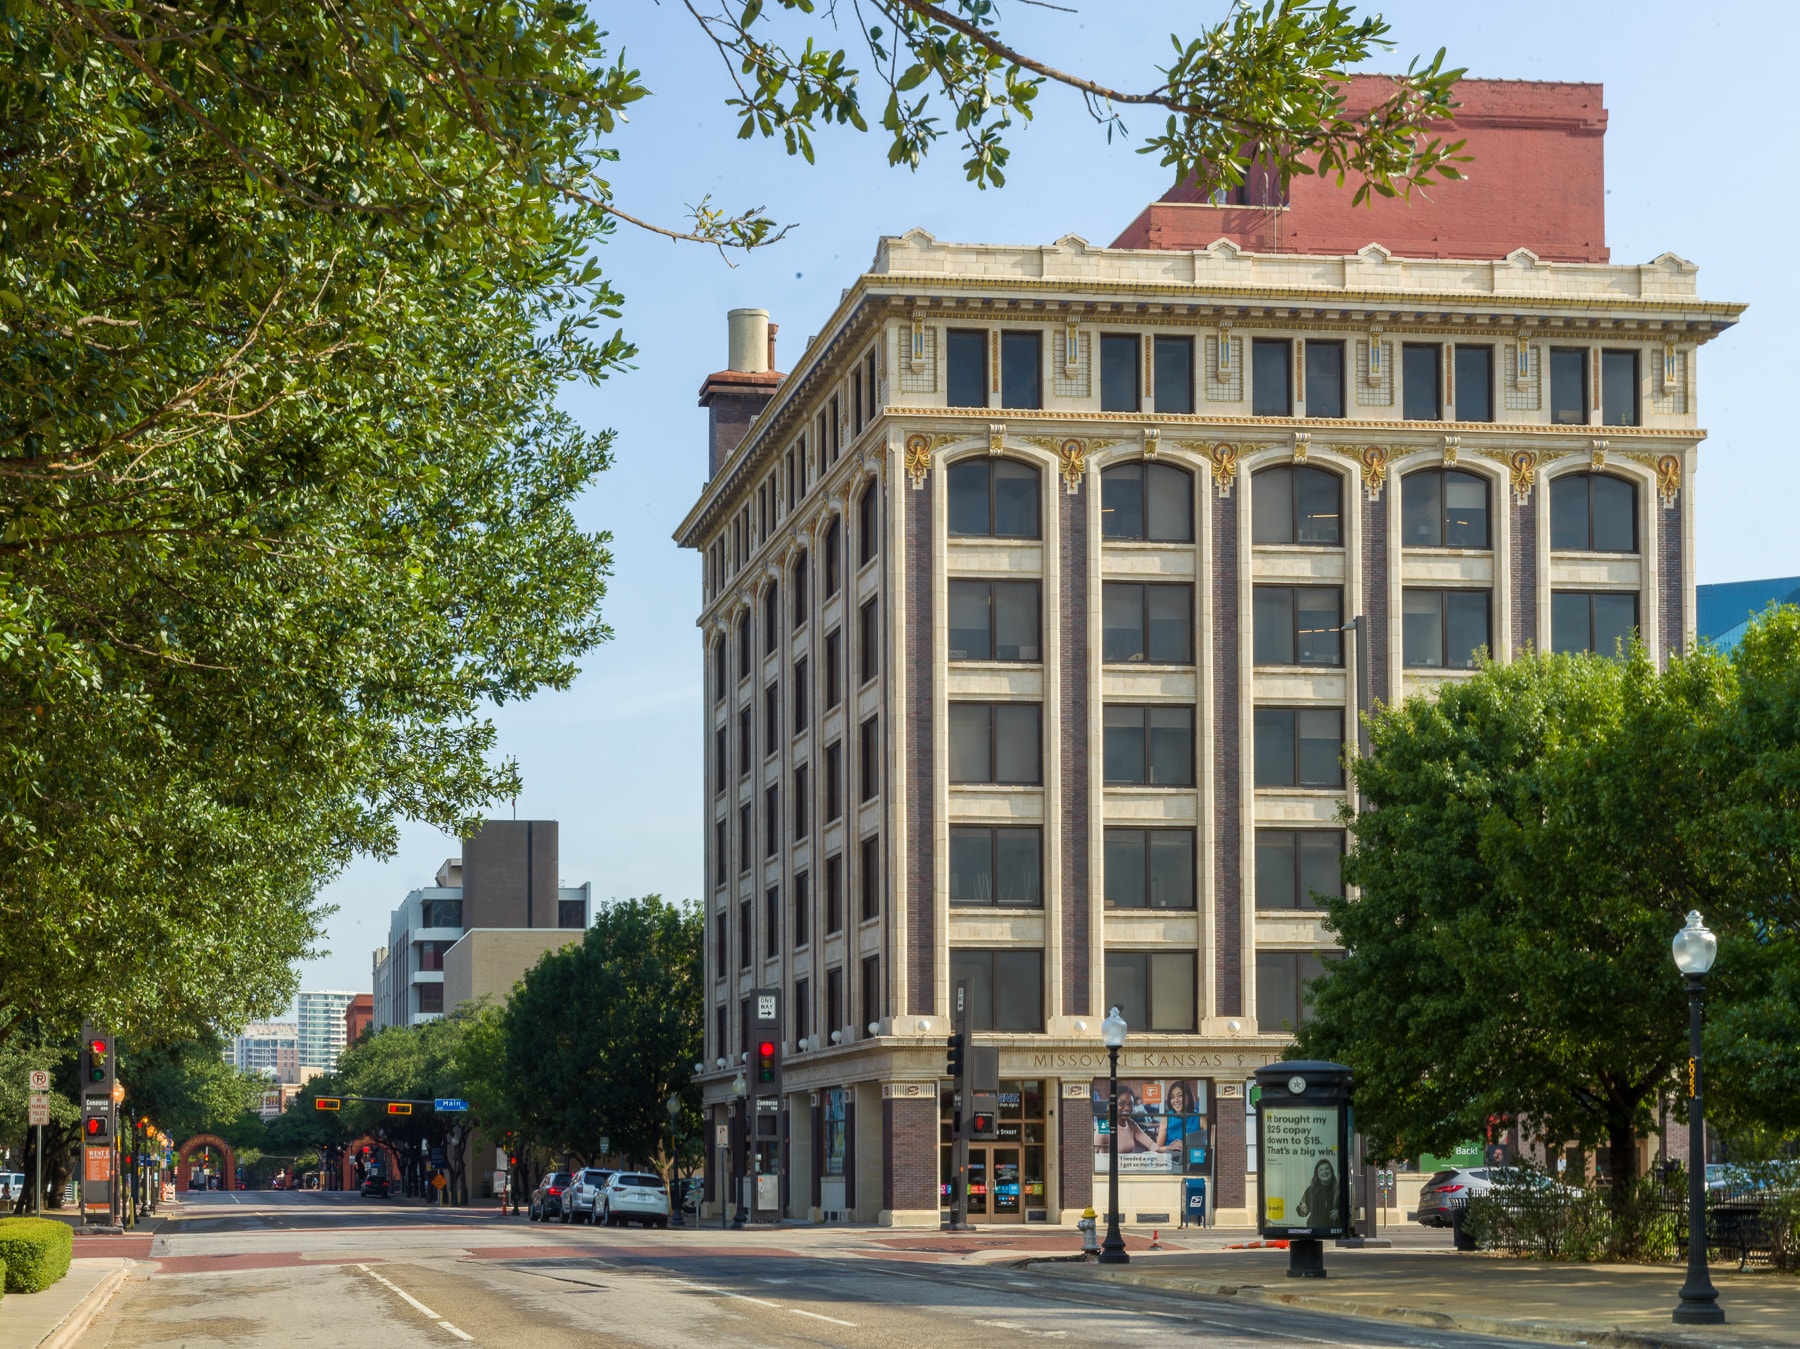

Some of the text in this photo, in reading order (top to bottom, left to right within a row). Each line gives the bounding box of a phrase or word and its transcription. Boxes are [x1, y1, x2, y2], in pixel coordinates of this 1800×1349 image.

[1034, 1054, 1127, 1067] MISSOVI
[1144, 1054, 1222, 1067] KANSAS
[1273, 1115, 1310, 1125] brought
[1312, 1116, 1327, 1125] my
[1266, 1124, 1312, 1135] $25 copay
[1266, 1136, 1323, 1145] down to $15.
[1266, 1146, 1290, 1155] That's
[1300, 1146, 1315, 1157] big
[1455, 1146, 1478, 1155] Back!
